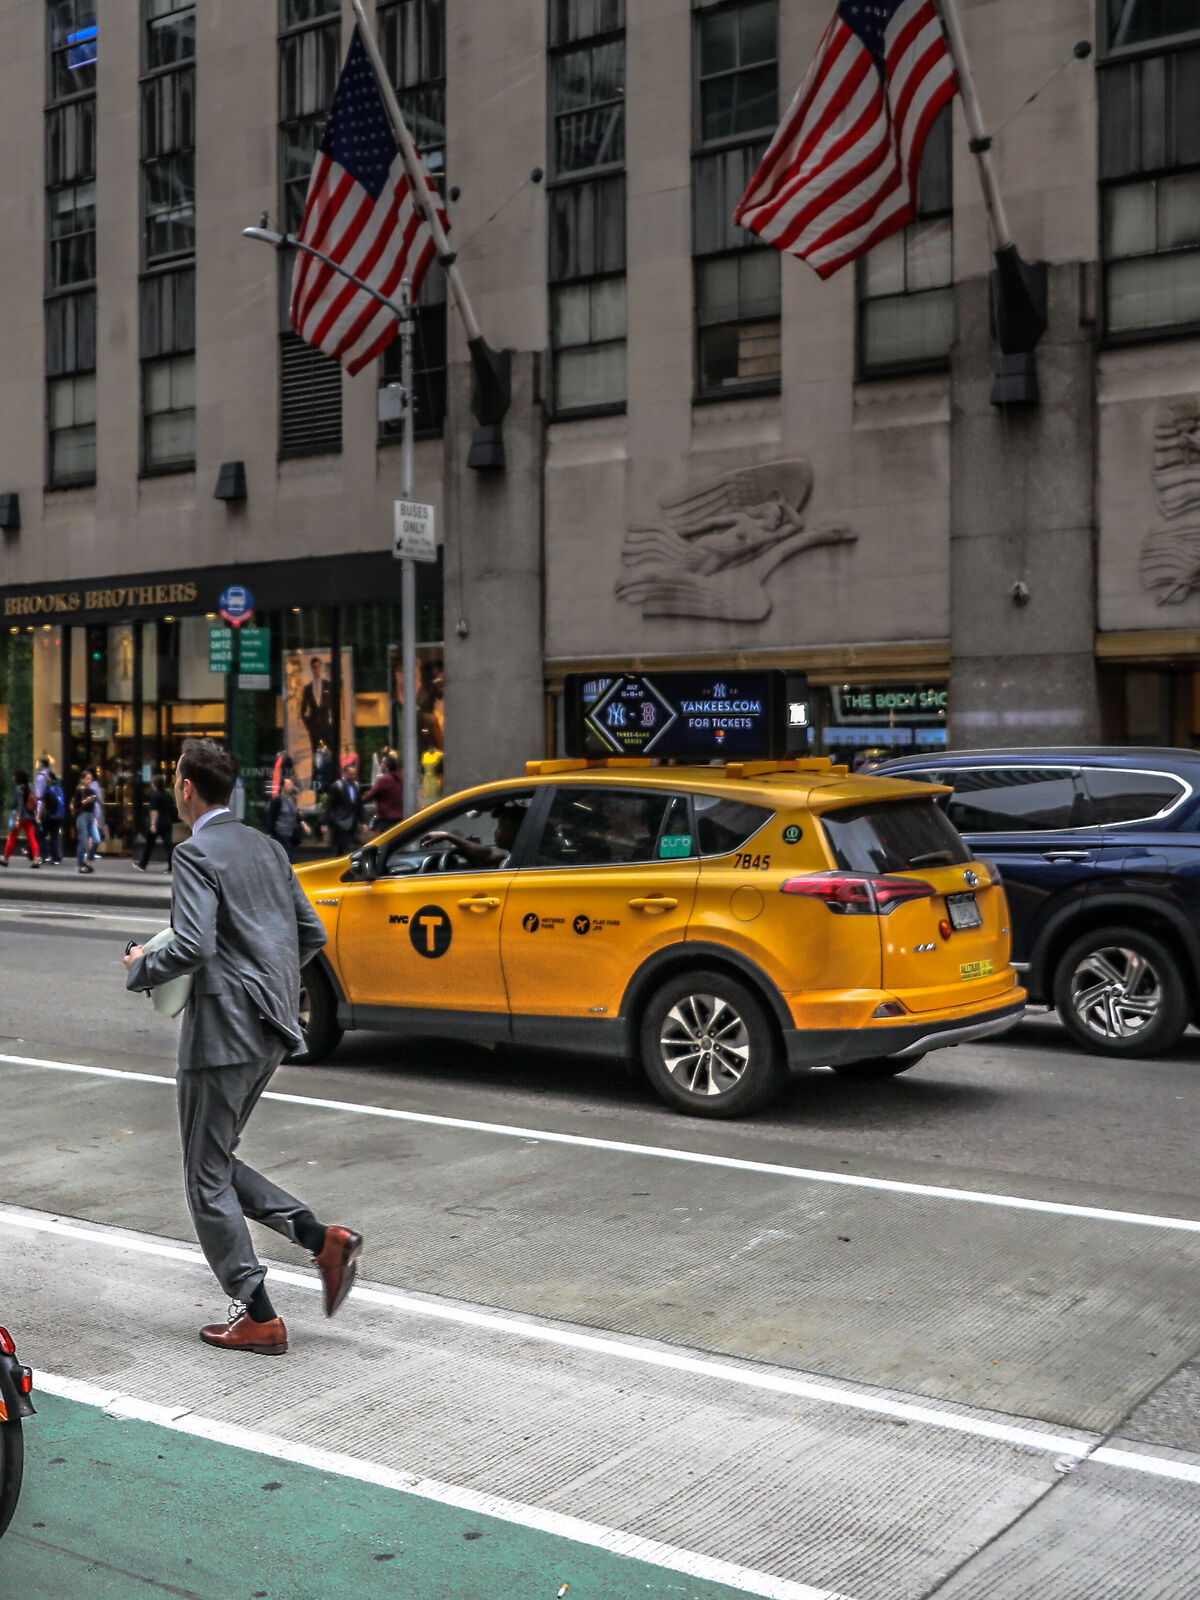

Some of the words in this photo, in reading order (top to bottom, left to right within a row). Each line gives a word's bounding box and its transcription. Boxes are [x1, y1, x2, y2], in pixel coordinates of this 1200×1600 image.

[400, 503, 428, 519] BUSES
[403, 519, 425, 534] ONLY
[4, 592, 80, 616] BROOKS
[85, 582, 197, 610] BROTHERS
[680, 700, 760, 712] YANKEES.COM
[843, 695, 872, 708] THE
[875, 694, 917, 708] BODY
[919, 691, 947, 706] SHO
[640, 702, 655, 726] B
[688, 718, 709, 727] FOR
[711, 718, 752, 727] TICKETS
[661, 836, 691, 847] curb
[734, 853, 770, 870] 7845
[389, 914, 409, 924] NYC
